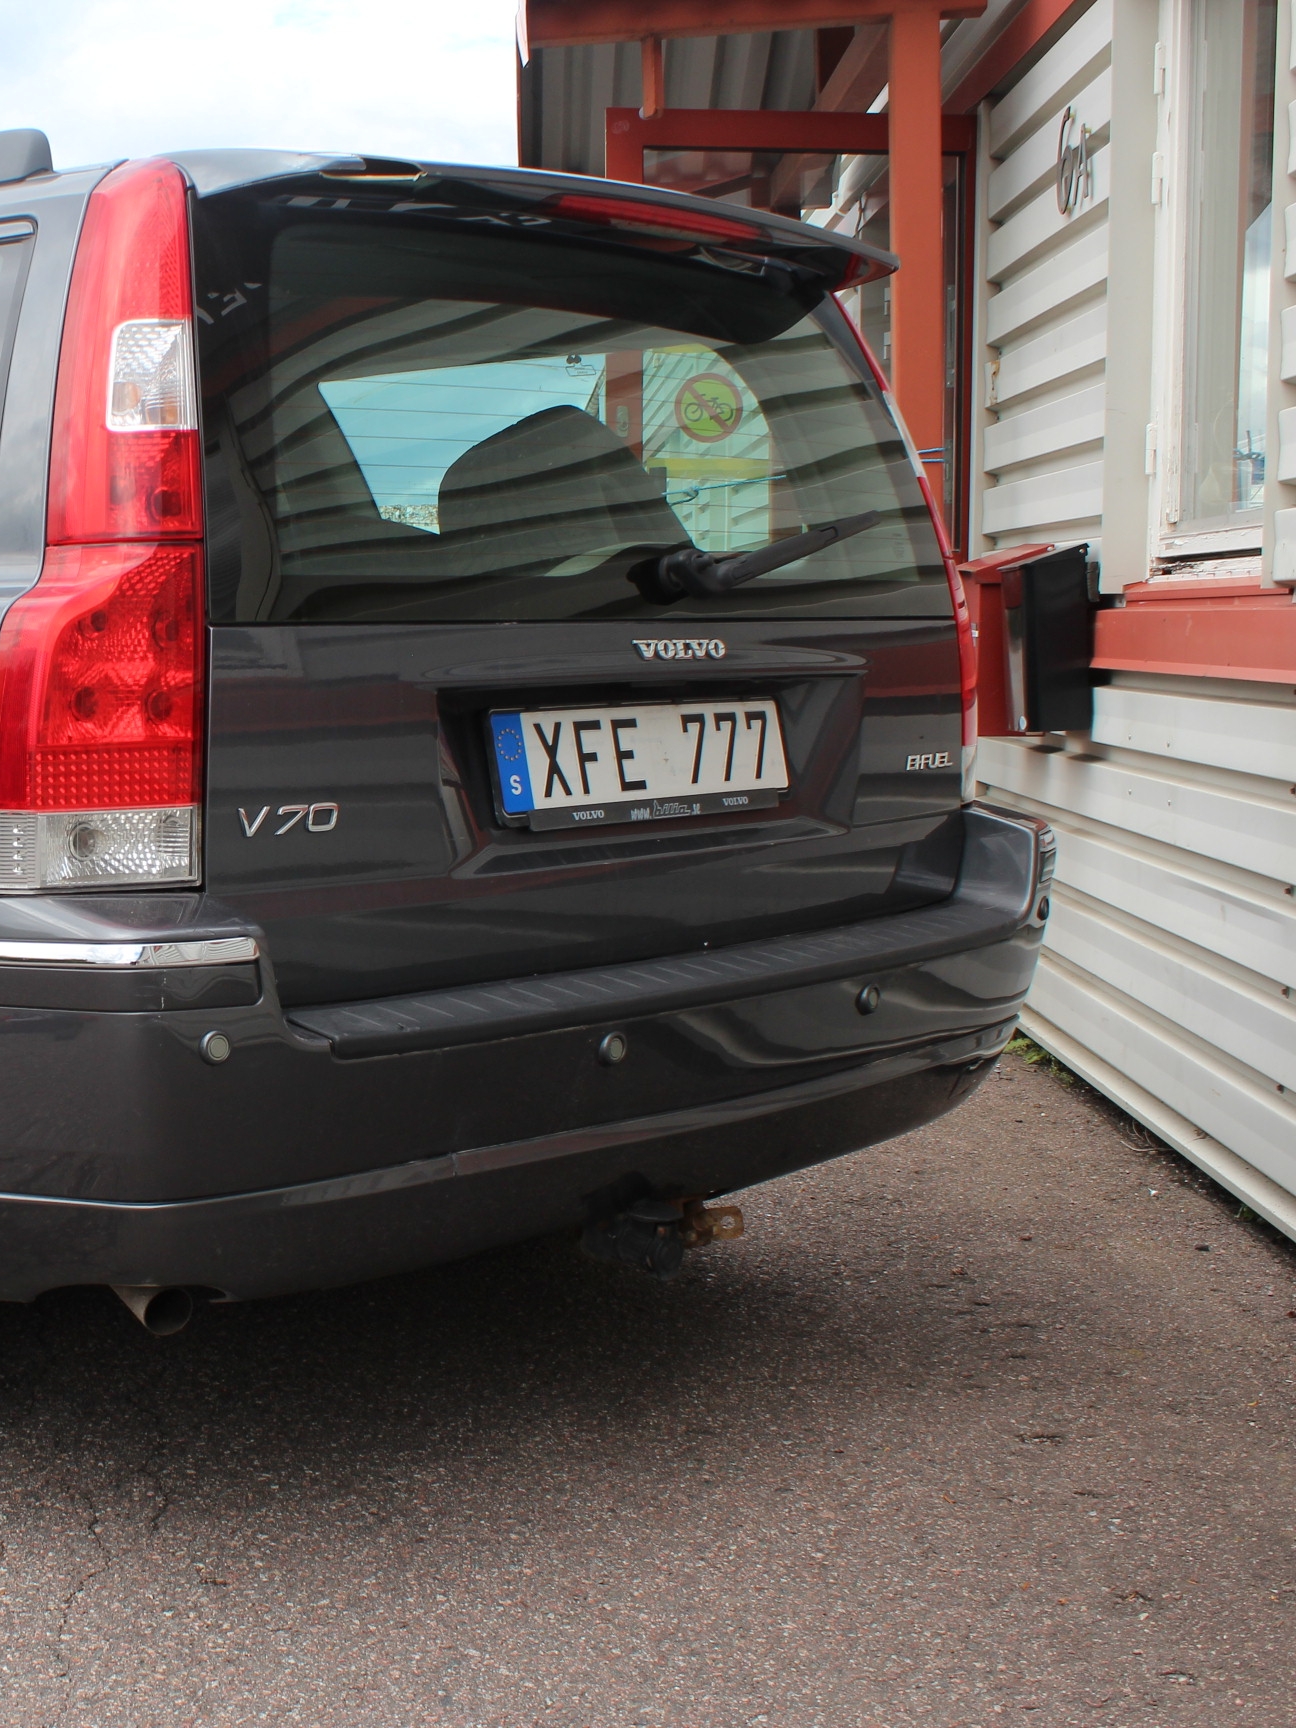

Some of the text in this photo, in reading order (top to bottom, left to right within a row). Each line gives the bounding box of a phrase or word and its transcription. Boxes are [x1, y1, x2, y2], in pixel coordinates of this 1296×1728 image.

[1056, 105, 1088, 215] 6A
[632, 639, 726, 660] VOLVO
[533, 711, 767, 797] XFE 777
[509, 775, 522, 795] S
[722, 795, 749, 807] VOLVO
[572, 810, 605, 821] VOLVO
